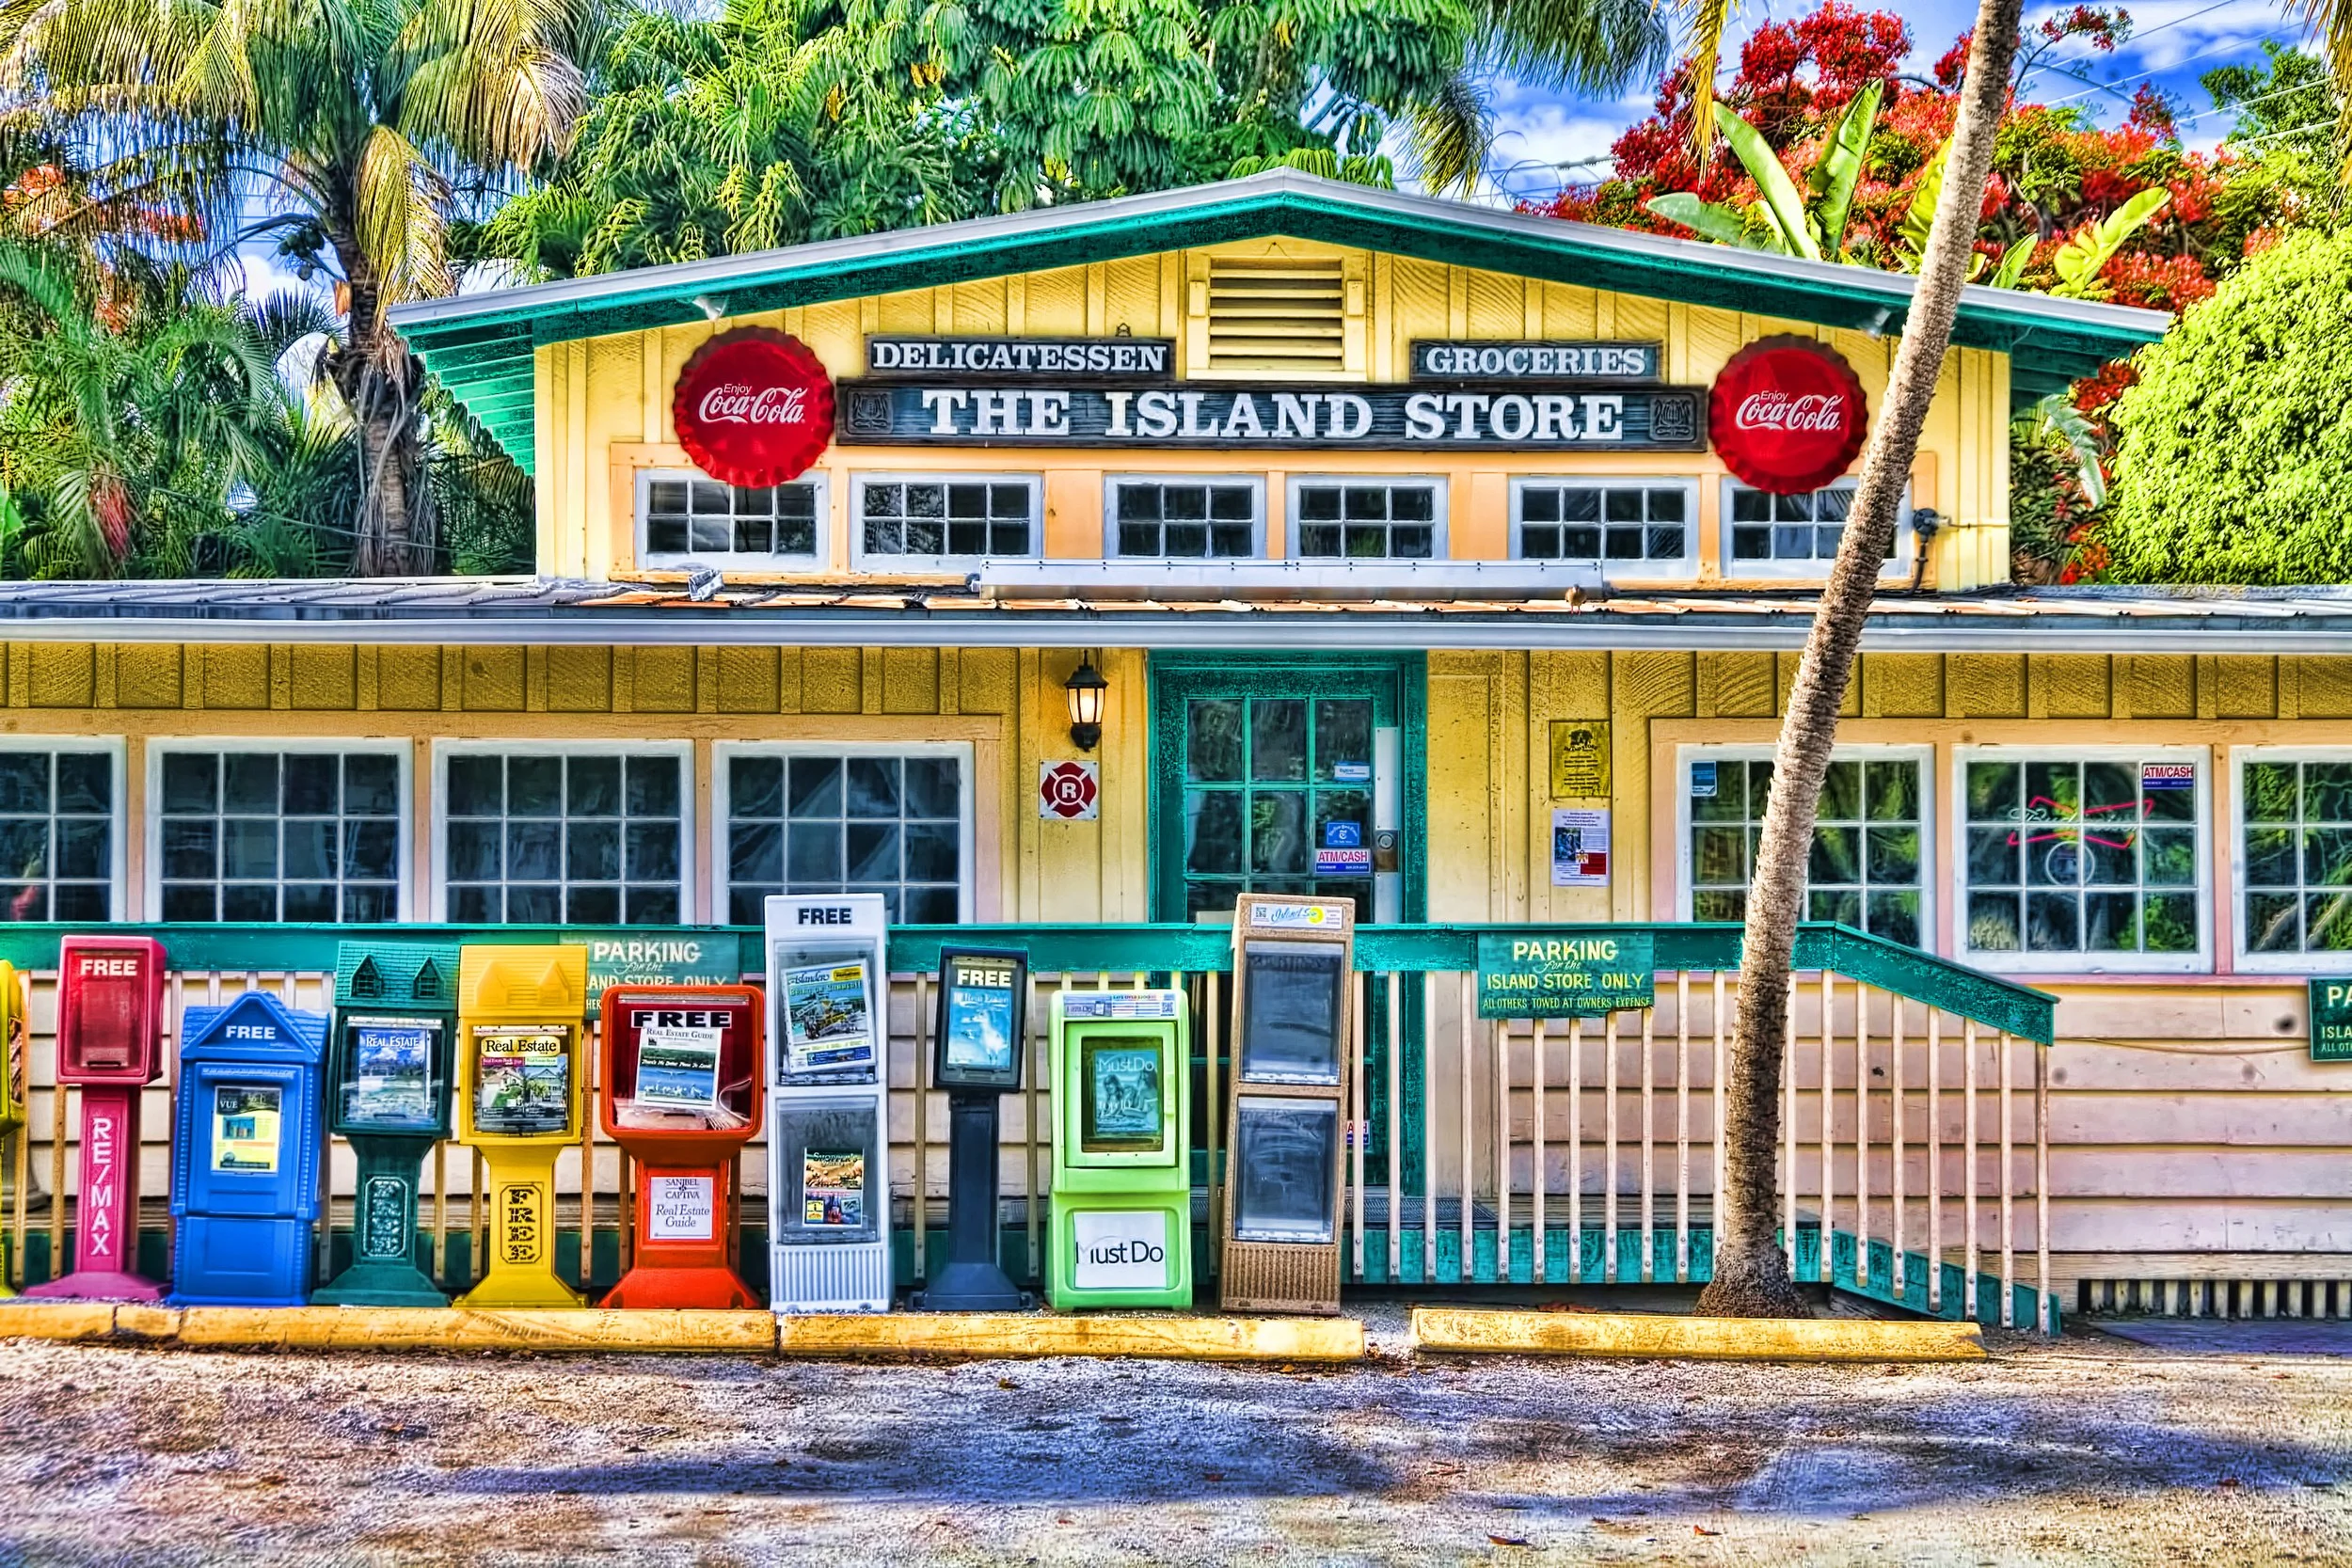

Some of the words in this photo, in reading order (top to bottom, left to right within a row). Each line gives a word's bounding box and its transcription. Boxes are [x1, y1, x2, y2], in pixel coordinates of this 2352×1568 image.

[873, 342, 1167, 372] DELICATESSEN
[1425, 346, 1646, 374] GROCERIES
[723, 383, 753, 395] Enjoy
[1760, 390, 1789, 403] Enjoy
[699, 387, 808, 424] Coca-Cola
[1736, 394, 1844, 430] Coca-Cola
[922, 390, 1070, 436] THE
[1104, 391, 1374, 438] ISLAND
[1405, 393, 1623, 439] STORE
[2144, 767, 2194, 777] ATM/CASH
[1061, 782, 1077, 799] R
[1318, 851, 1368, 862] ATM/CASH
[798, 908, 852, 925] FREE
[593, 942, 702, 963] PARKING
[1513, 940, 1619, 961] PARKING
[80, 958, 138, 976] FREE
[613, 961, 644, 974] for
[645, 961, 663, 972] the
[1533, 959, 1563, 974] for
[1565, 959, 1581, 970] the
[586, 974, 618, 990] AND
[957, 969, 1011, 987] FREE
[1486, 973, 1538, 989] ISLAND
[1544, 973, 1592, 989] STORE
[1602, 973, 1645, 989] ONLY
[1483, 997, 1496, 1008] ALL
[1497, 998, 1528, 1008] OTHERS
[1532, 997, 1559, 1008] TOWED
[1562, 997, 1574, 1008] AT
[1578, 997, 1612, 1008] OWNERS
[1615, 997, 1651, 1007] EXPENSE
[633, 1011, 730, 1027] FREE
[225, 1025, 276, 1039] FREE
[666, 1029, 690, 1037] ESTATE
[691, 1031, 714, 1039] GUIDE
[2322, 1026, 2352, 1038] ISLA
[367, 1036, 386, 1047] REAL
[389, 1036, 419, 1048] ESTATE
[485, 1039, 514, 1053] Real
[517, 1039, 557, 1053] Estate
[2321, 1042, 2336, 1052] ALL
[219, 1101, 238, 1109] VUE
[90, 1117, 113, 1256] RE/MAX
[665, 1191, 700, 1199] CAPTIVA
[656, 1204, 677, 1215] Real
[679, 1204, 709, 1215] Estate
[508, 1189, 535, 1260] FREE
[665, 1216, 696, 1227] Guide
[1075, 1241, 1128, 1264] Must
[1131, 1240, 1164, 1263] Do
